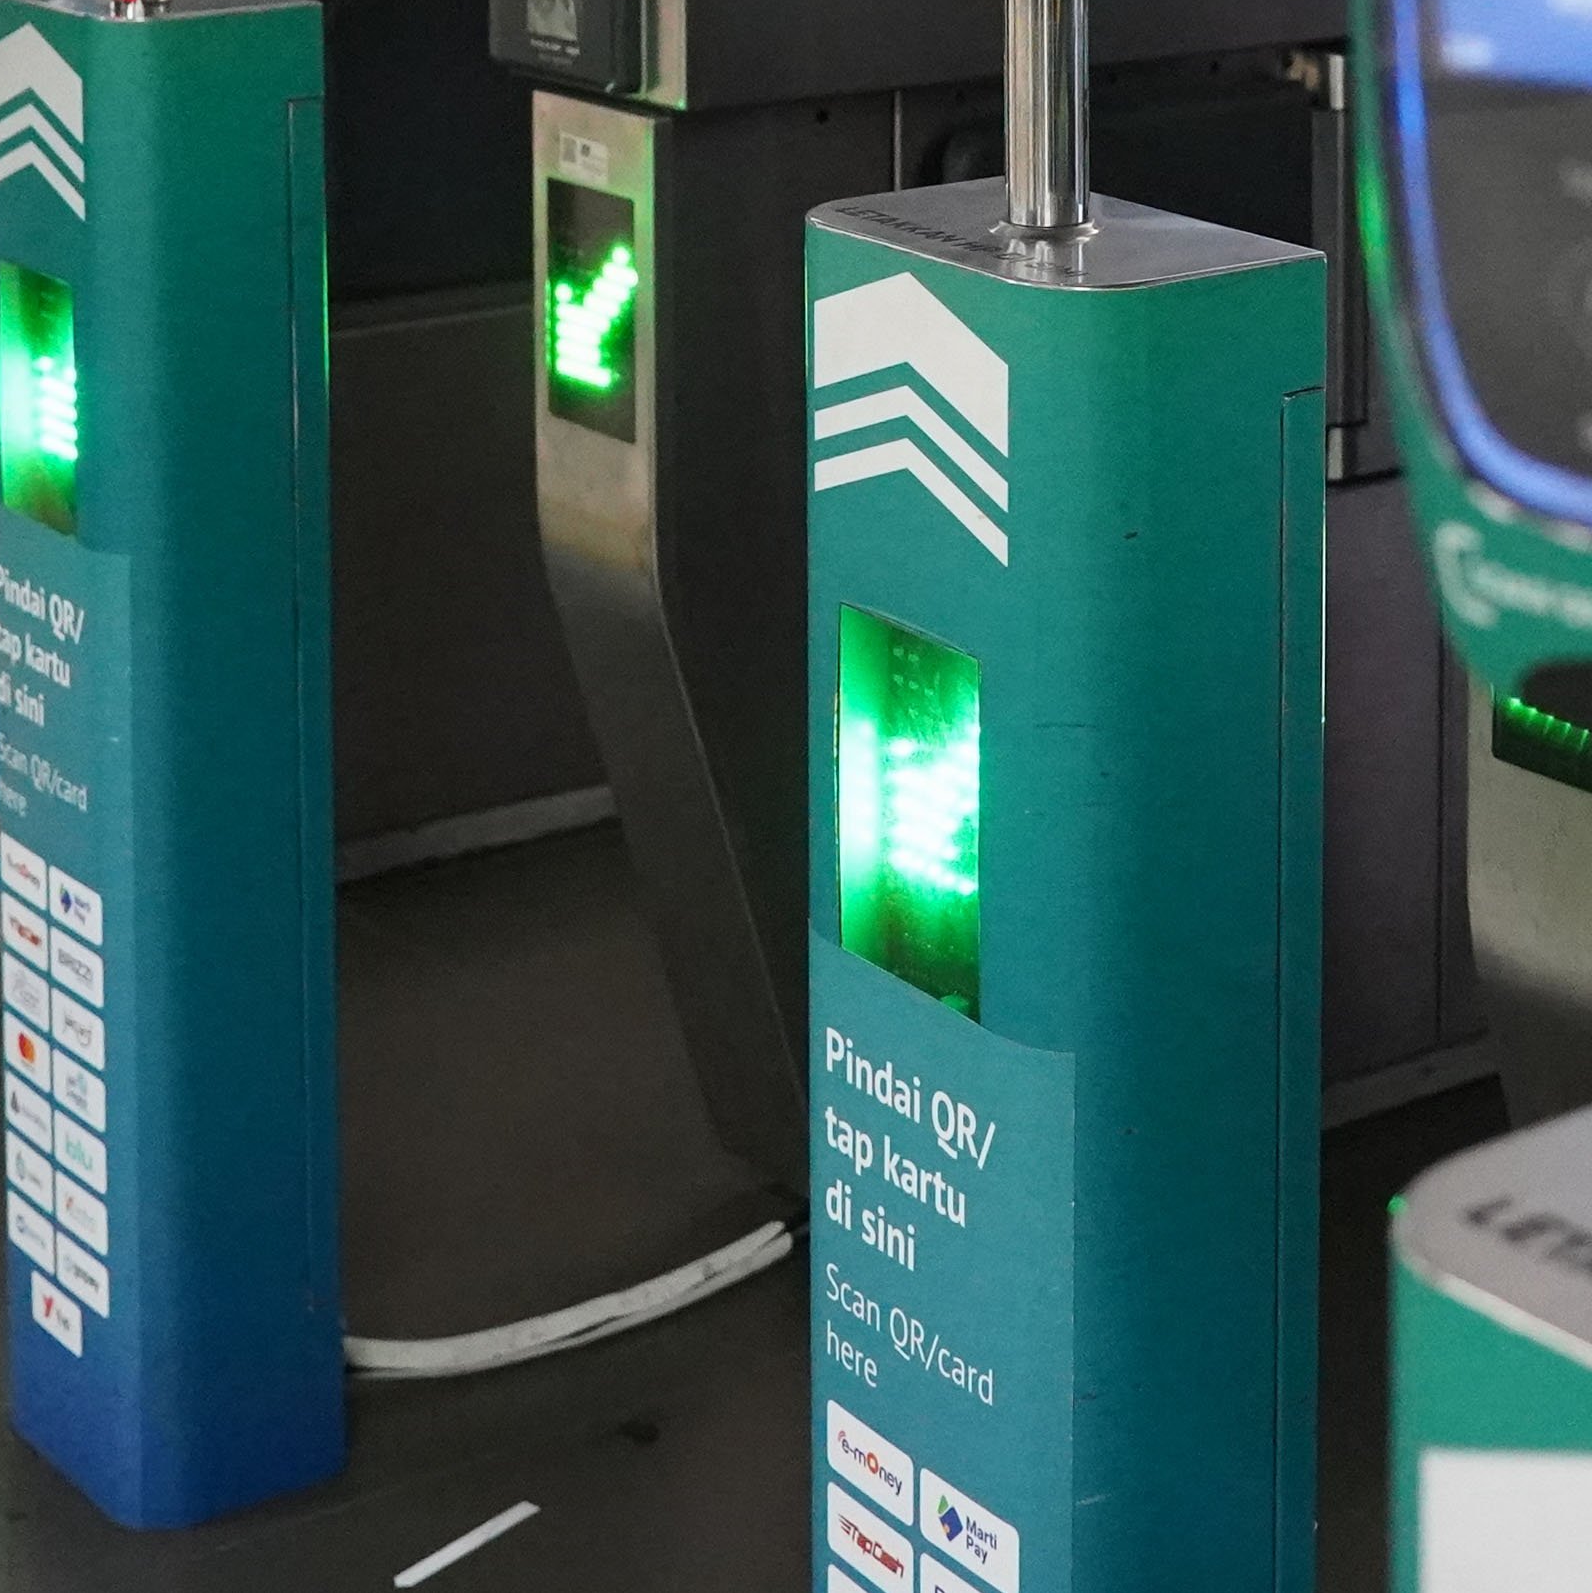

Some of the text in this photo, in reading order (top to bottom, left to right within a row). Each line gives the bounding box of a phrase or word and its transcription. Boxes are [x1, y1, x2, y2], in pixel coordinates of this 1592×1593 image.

[49, 593, 85, 645] QR/
[25, 633, 71, 689] kartu
[15, 684, 45, 728] sini
[31, 753, 88, 813] QR/card
[826, 1026, 996, 1170] Pindai QR/
[825, 1106, 966, 1228] tap kartu
[825, 1179, 916, 1271] di sini
[826, 1262, 994, 1407] Scan QR/card
[826, 1319, 878, 1388] here
[838, 1513, 905, 1579] TapCash
[965, 1515, 998, 1551] Marti
[965, 1535, 989, 1565] Pay
